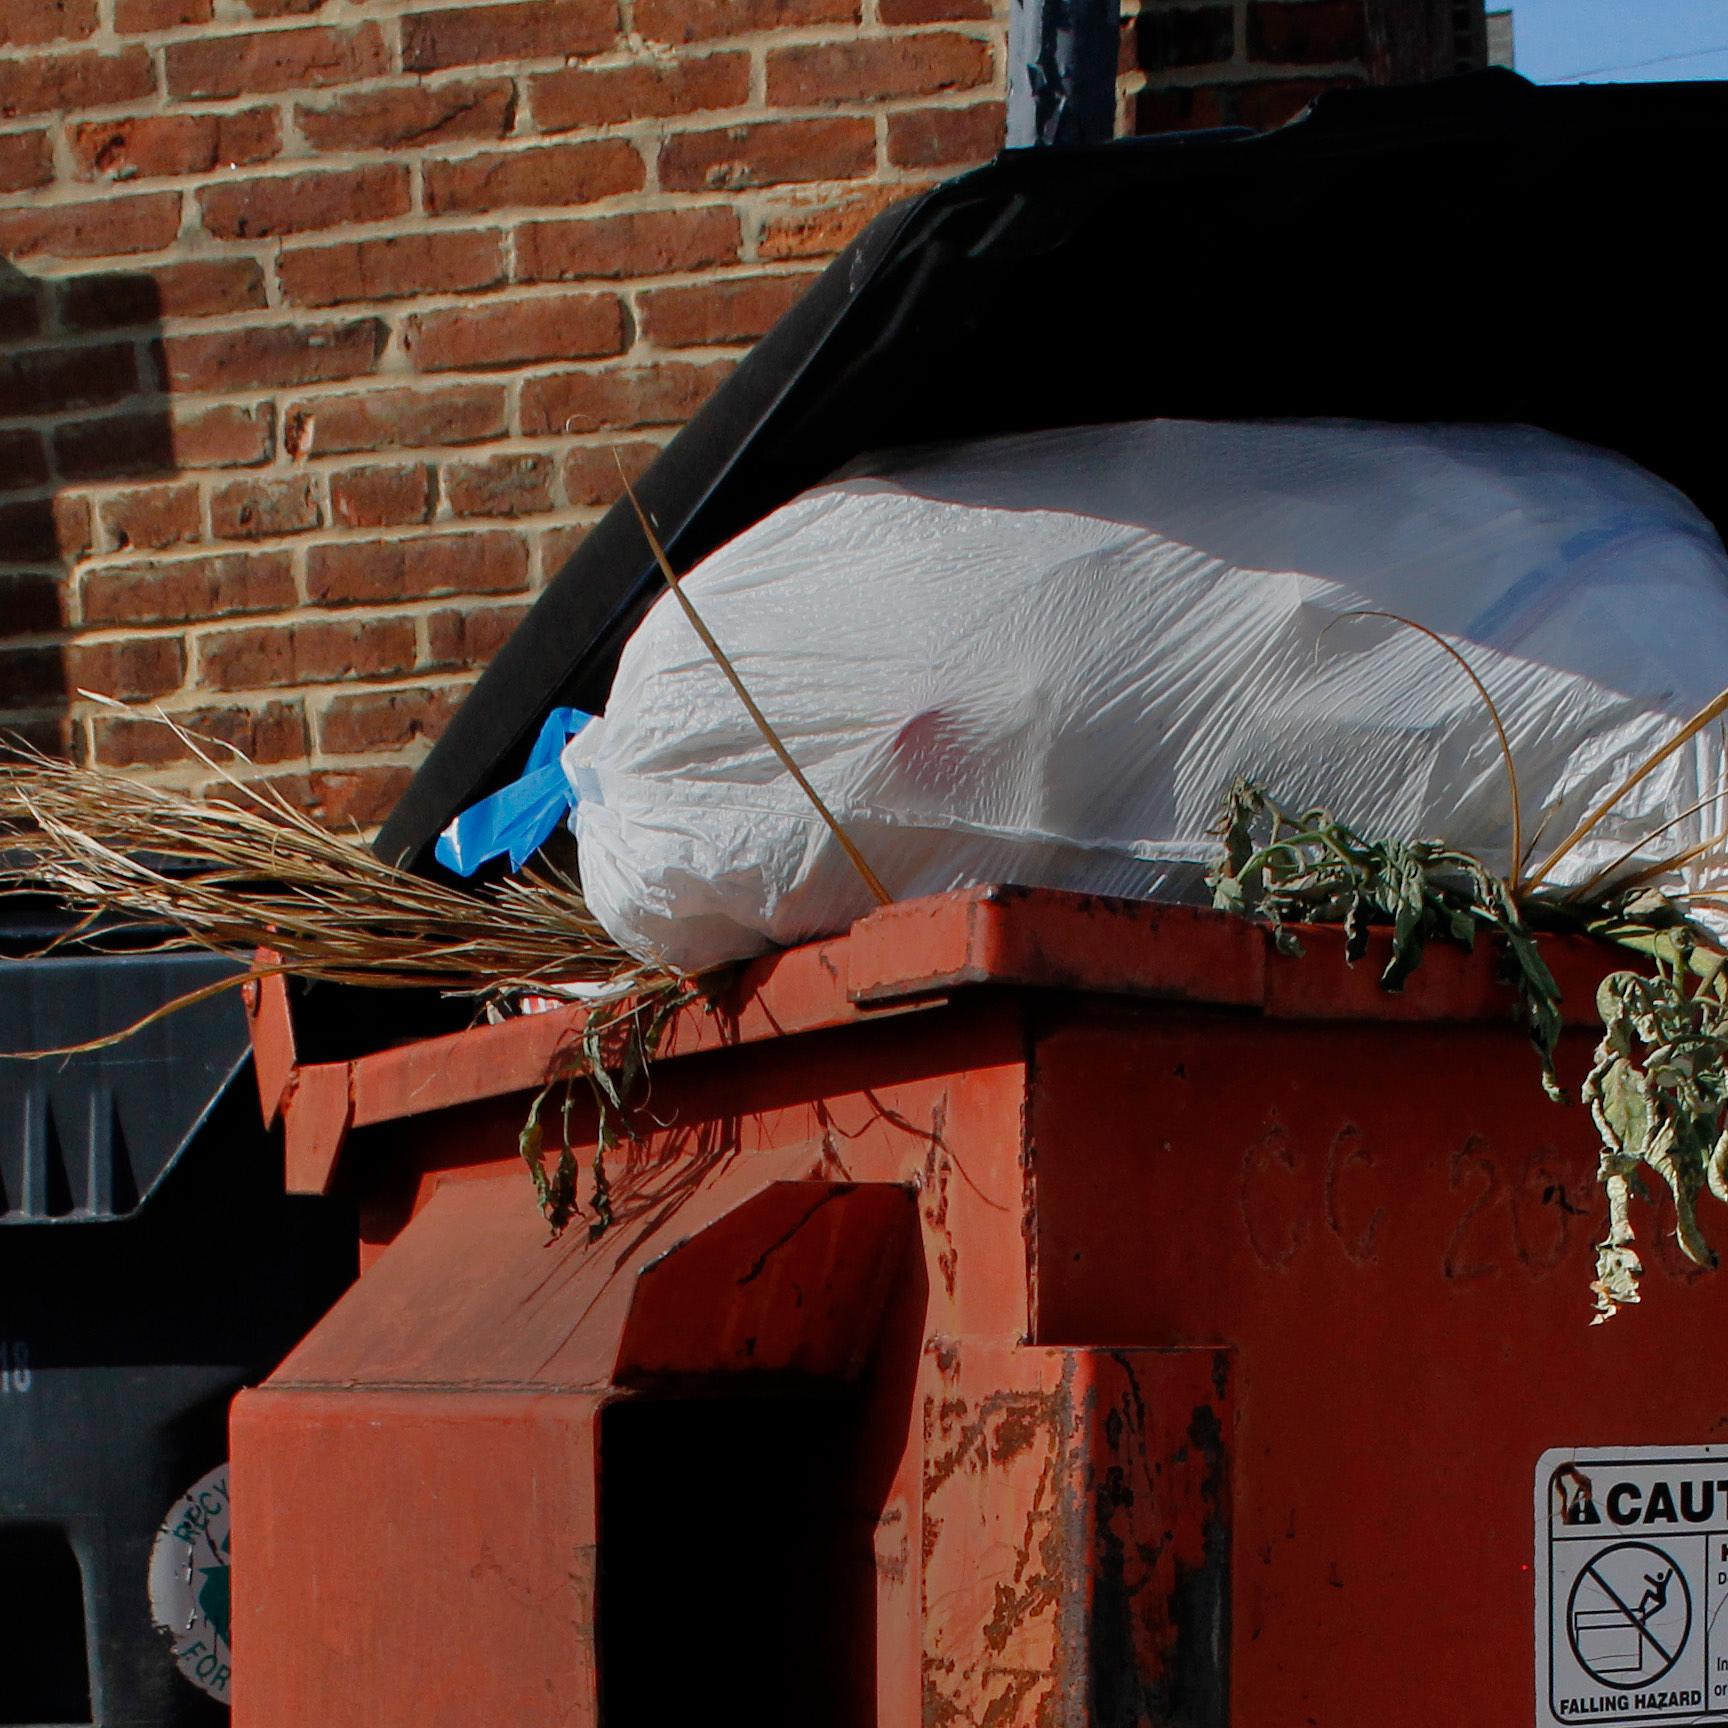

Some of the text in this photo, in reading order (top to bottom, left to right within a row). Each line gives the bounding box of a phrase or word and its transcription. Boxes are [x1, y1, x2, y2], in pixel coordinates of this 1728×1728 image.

[173, 1478, 230, 1544] RECY
[1560, 1690, 1702, 1715] FALLING HAZARD
[1714, 1684, 1727, 1696] or
